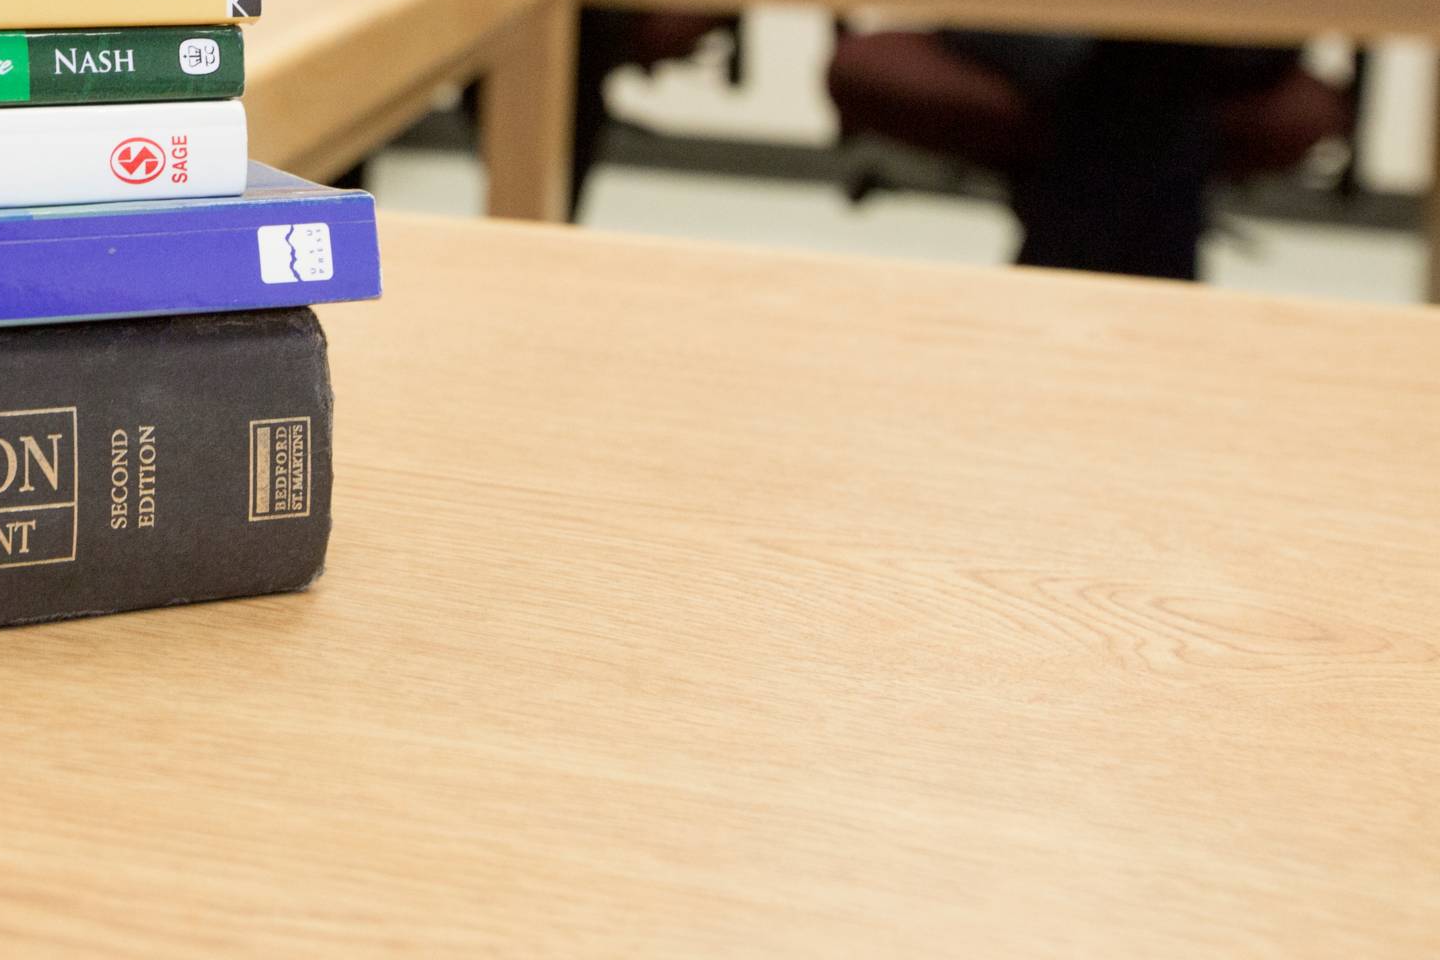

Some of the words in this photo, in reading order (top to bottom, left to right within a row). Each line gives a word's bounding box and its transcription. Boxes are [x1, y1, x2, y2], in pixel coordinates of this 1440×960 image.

[54, 47, 136, 74] NASH
[172, 135, 187, 183] SAGE
[111, 428, 128, 529] SECOND
[138, 425, 156, 528] EDITION
[275, 426, 288, 511] BEDFORD
